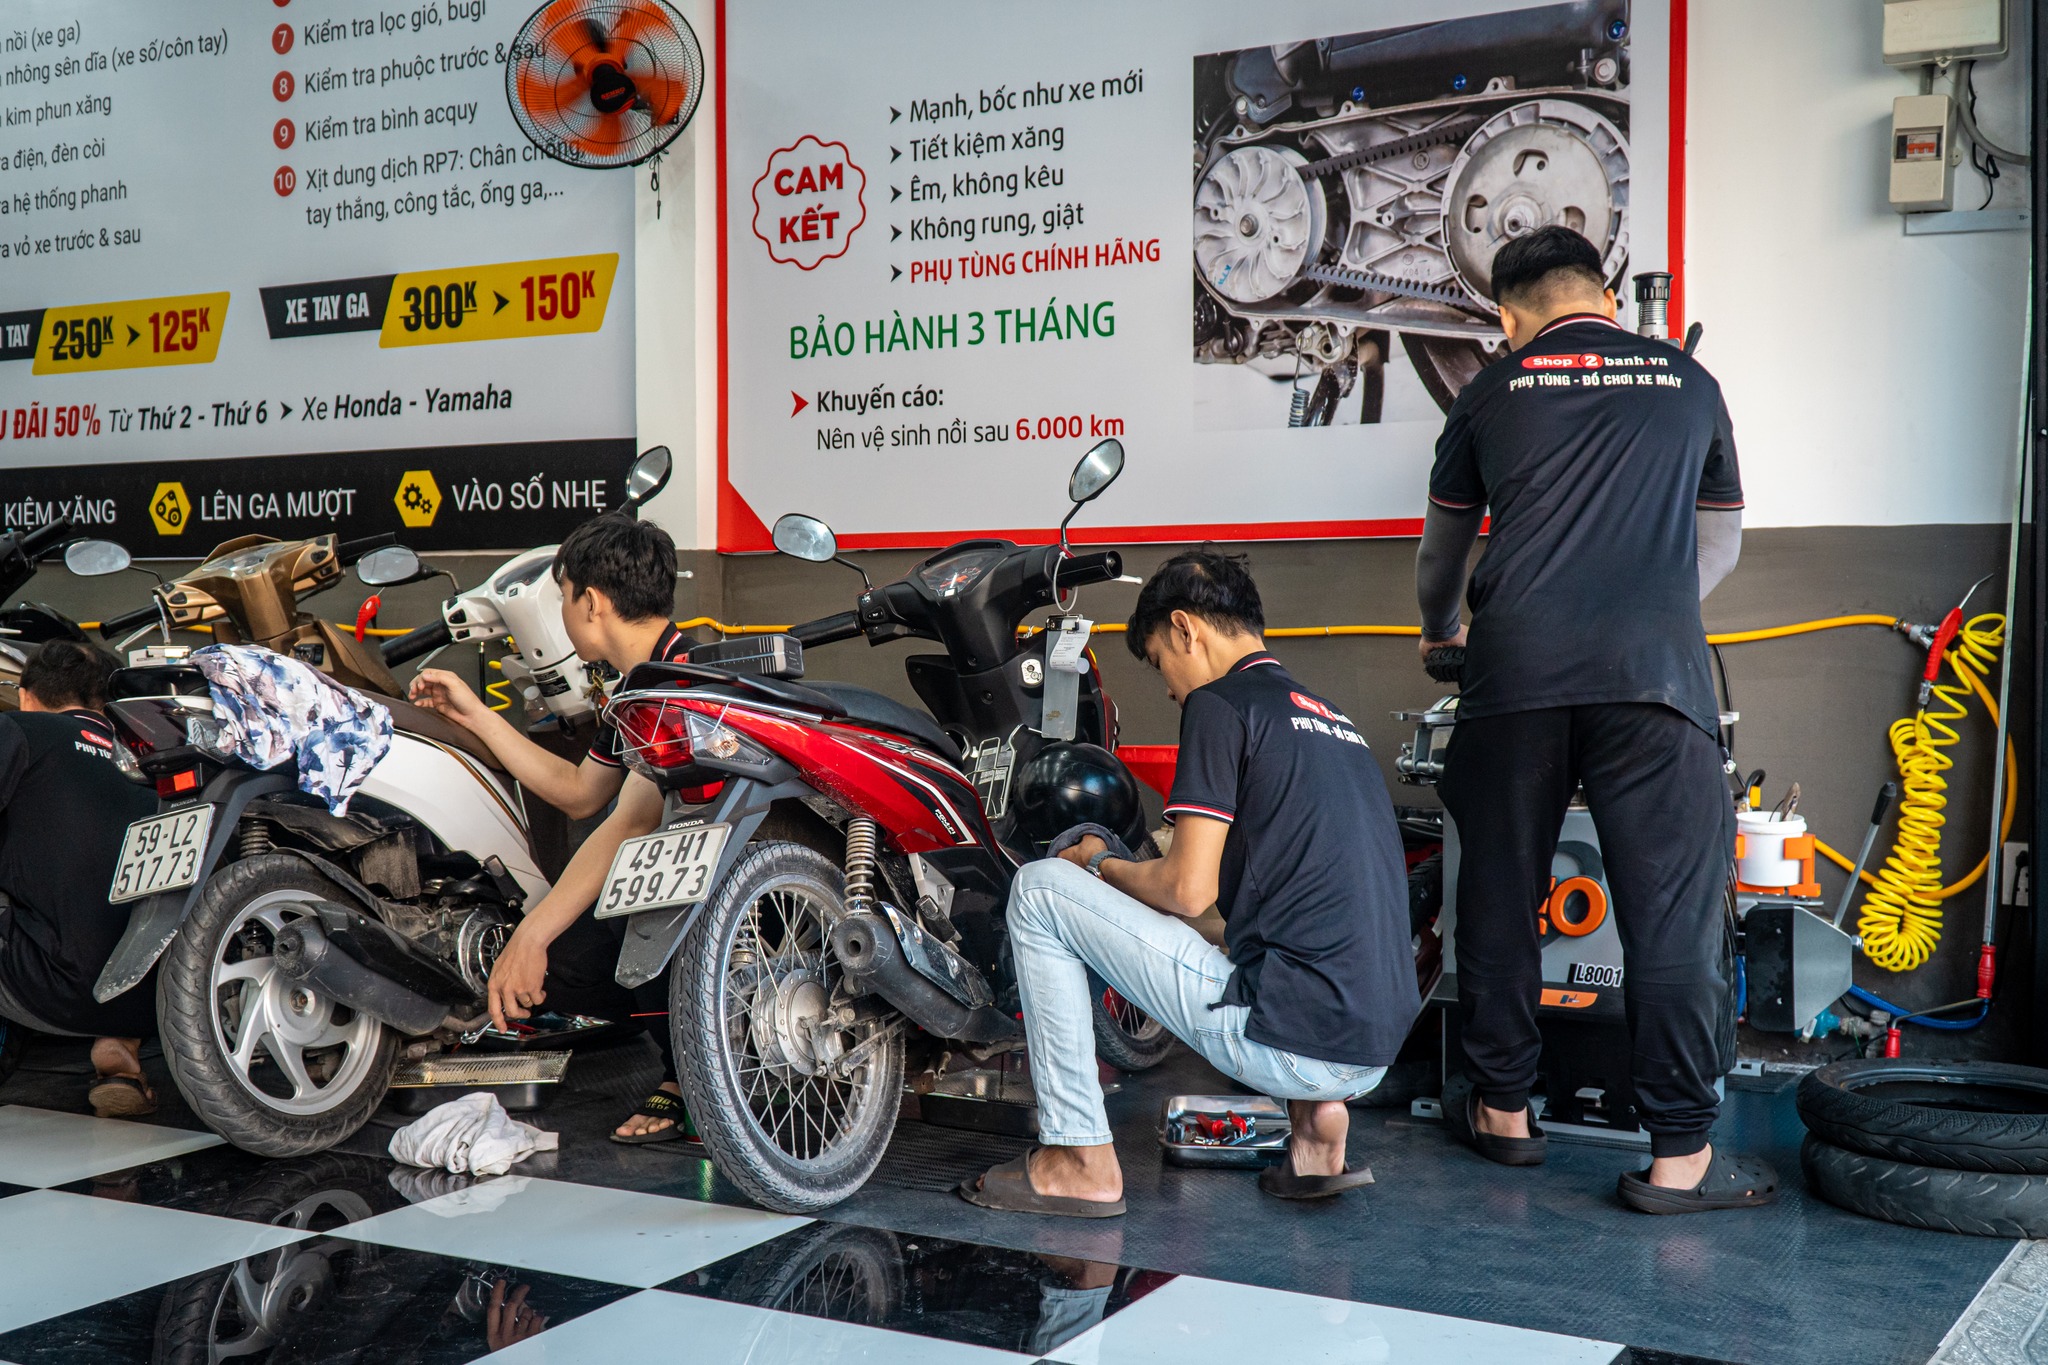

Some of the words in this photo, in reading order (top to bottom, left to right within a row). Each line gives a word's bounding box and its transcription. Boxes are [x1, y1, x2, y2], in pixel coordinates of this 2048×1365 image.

[6, 30, 27, 52] nồi
[32, 27, 53, 52] (xe
[57, 20, 80, 47] ga)
[278, 30, 288, 47] 7
[304, 18, 347, 46] Kiểm
[352, 18, 374, 37] tra
[380, 11, 406, 36] lọc
[411, 2, 442, 32] gió,
[6, 63, 50, 85] nhông
[54, 56, 80, 77] sên
[112, 46, 135, 72] (xe
[139, 37, 194, 64] số/côn
[198, 28, 229, 55] tay)
[279, 78, 288, 94] 8
[304, 67, 347, 94] Kiểm
[352, 66, 375, 85] tra
[380, 54, 435, 85] phuộc
[440, 45, 489, 73] trước
[495, 42, 507, 64] &
[512, 40, 546, 61] sau
[6, 107, 31, 126] kim
[36, 101, 71, 126] phun
[76, 94, 111, 116] xăng
[910, 93, 973, 123] Mạnh,
[979, 86, 1017, 114] bốc
[1022, 82, 1064, 108] như
[1068, 79, 1095, 102] xe
[1101, 68, 1144, 98] mới
[279, 125, 288, 142] 9
[304, 115, 348, 142] Kiểm
[352, 112, 376, 131] tra
[381, 103, 418, 130] bình
[424, 101, 478, 127] acquy
[13, 147, 47, 171] điện,
[51, 143, 78, 163] đèn
[83, 138, 105, 159] còi
[910, 133, 948, 162] Tiết
[954, 130, 1006, 158] kiệm
[1011, 125, 1065, 152] xăng
[276, 172, 294, 190] 10
[305, 162, 329, 190] Xịt
[333, 160, 376, 188] dung
[381, 153, 418, 183] dịch
[423, 150, 464, 176] RP7:
[469, 143, 516, 169] Chân
[774, 163, 843, 196] CAM
[910, 176, 947, 203] Êm,
[953, 171, 1018, 199] không
[1024, 165, 1064, 190] kêu
[13, 192, 31, 215] hệ
[35, 186, 76, 211] thống
[81, 179, 127, 209] phanh
[305, 203, 331, 228] tay
[336, 195, 390, 224] thắng,
[394, 192, 438, 217] công
[442, 184, 475, 209] tắc,
[480, 180, 515, 207] ống
[13, 234, 31, 257] vỏ
[34, 238, 51, 255] xe
[55, 229, 95, 252] trước
[99, 227, 109, 247] &
[113, 228, 141, 246] sau
[779, 204, 839, 244] KẾT
[910, 213, 976, 242] Không
[981, 214, 1037, 238] rung,
[1042, 203, 1084, 232] giật
[910, 259, 953, 285] PHỤ
[958, 248, 1016, 280] TÙNG
[1021, 244, 1089, 273] CHÍNH
[1095, 238, 1161, 267] HÃNG
[285, 299, 308, 325] XE
[311, 296, 341, 323] TAY
[345, 292, 369, 319] GA
[400, 280, 477, 332] 300K
[520, 269, 595, 322] 150K
[6, 324, 30, 348] TAY
[49, 315, 114, 361] 250K
[148, 307, 210, 353] 125K
[790, 314, 855, 360] BẢO
[865, 310, 958, 354] HÀNH
[967, 312, 985, 345] 3
[994, 297, 1115, 344] THÁNG
[1533, 357, 1573, 367] Shop
[1584, 355, 1599, 367] 2
[1604, 355, 1668, 367] banh.vn
[817, 383, 895, 415] Khuyến
[901, 383, 944, 408] cáo:
[1509, 374, 1535, 391] PHỤ
[1537, 372, 1571, 386] TÙNG
[1603, 373, 1634, 386] CHƠI
[1636, 374, 1653, 385] XE
[1656, 373, 1682, 389] MÁY
[13, 401, 48, 440] ĐÃI
[54, 403, 101, 437] 50%
[109, 408, 132, 432] Từ
[137, 403, 176, 431] Thứ
[180, 406, 192, 429] 2
[210, 400, 252, 427] Thứ
[256, 401, 267, 425] 6
[301, 396, 328, 422] Xe
[333, 390, 401, 420] Honda
[424, 383, 512, 415] Yamaha
[817, 425, 855, 450] Nên
[861, 425, 885, 452] vệ
[890, 423, 931, 447] sinh
[937, 416, 967, 445] nồi
[973, 422, 1009, 443] sau
[1015, 415, 1083, 441] 6.000
[1090, 414, 1125, 437] km
[201, 488, 242, 522] LÊN
[249, 493, 280, 519] GA
[287, 488, 356, 524] MƯỢT
[452, 477, 503, 512] VÀO
[510, 472, 544, 509] SỐ
[552, 480, 607, 513] NHẸ
[5, 496, 53, 530] KIỆM
[59, 495, 116, 524] XĂNG
[1290, 717, 1313, 732] PHỤ
[74, 741, 97, 756] PHỤ
[134, 814, 198, 857] 59-L2
[667, 819, 705, 830] HONDA
[629, 830, 709, 872] 49-H1
[117, 848, 197, 895] 517.73
[605, 864, 709, 910] 599.73
[1574, 962, 1624, 988] L8001
